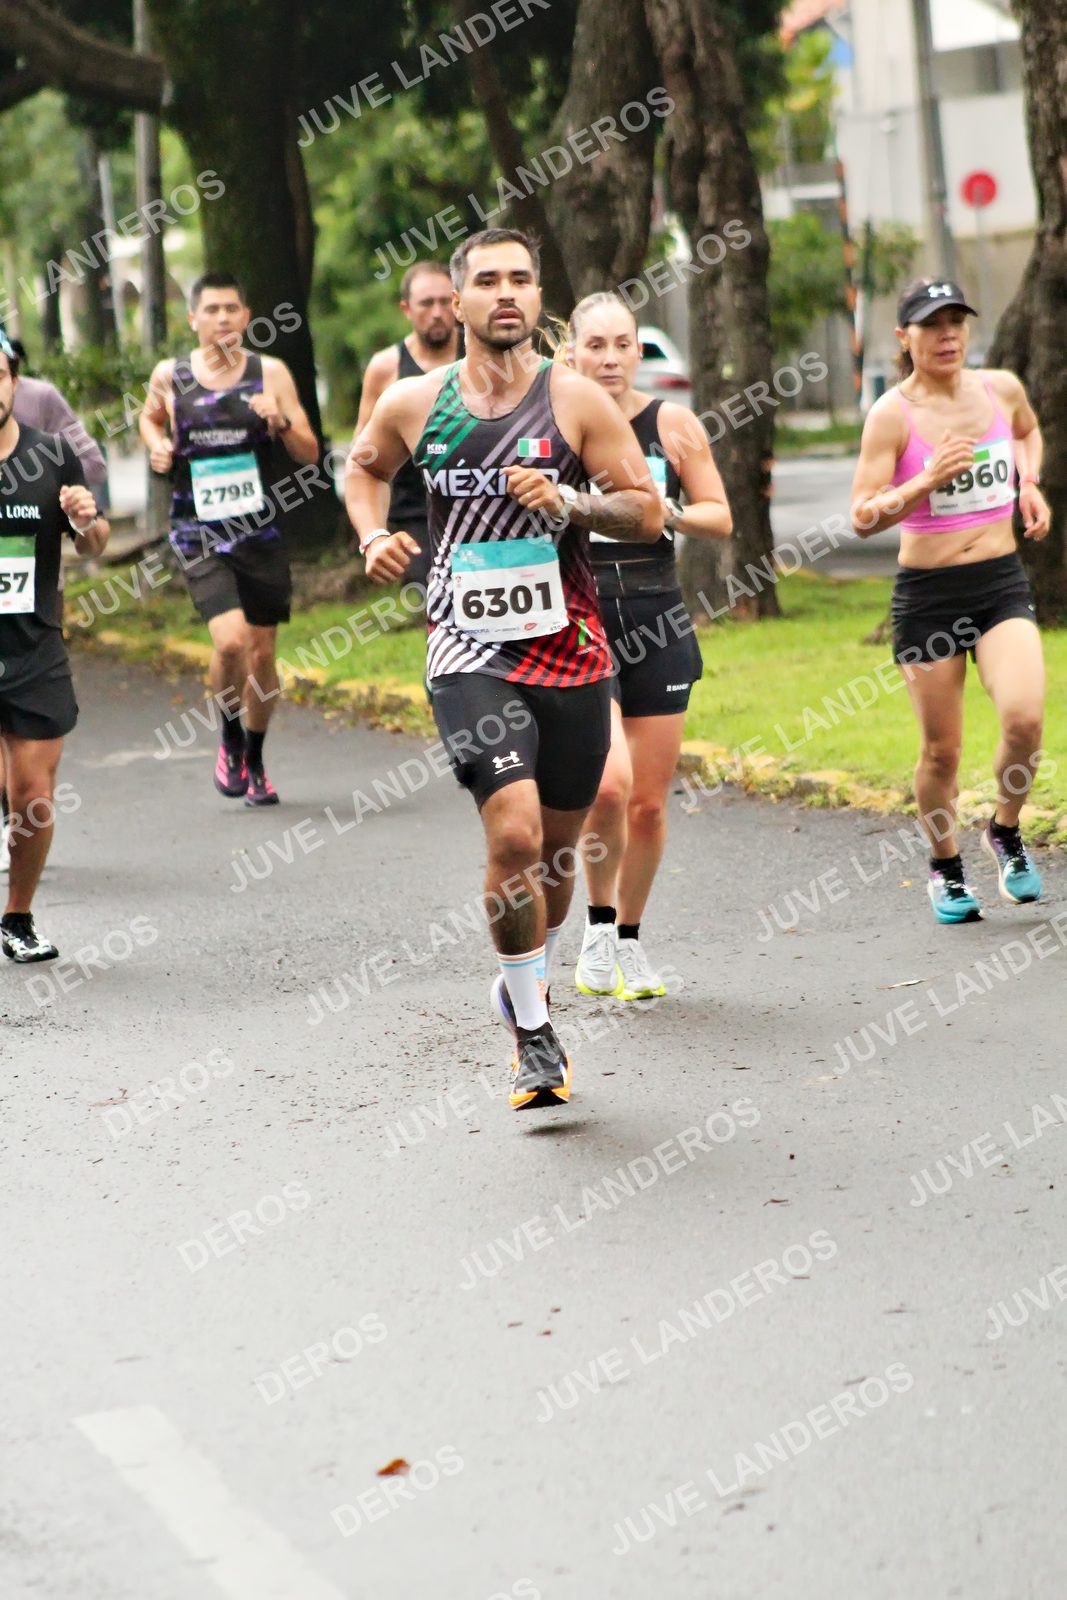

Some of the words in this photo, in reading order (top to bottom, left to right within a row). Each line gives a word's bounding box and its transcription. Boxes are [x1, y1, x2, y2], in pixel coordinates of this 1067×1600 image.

[423, 458, 560, 496] MÉXI
[200, 481, 255, 505] 2798
[6, 504, 41, 519] LOCAL
[462, 581, 552, 619] 6301
